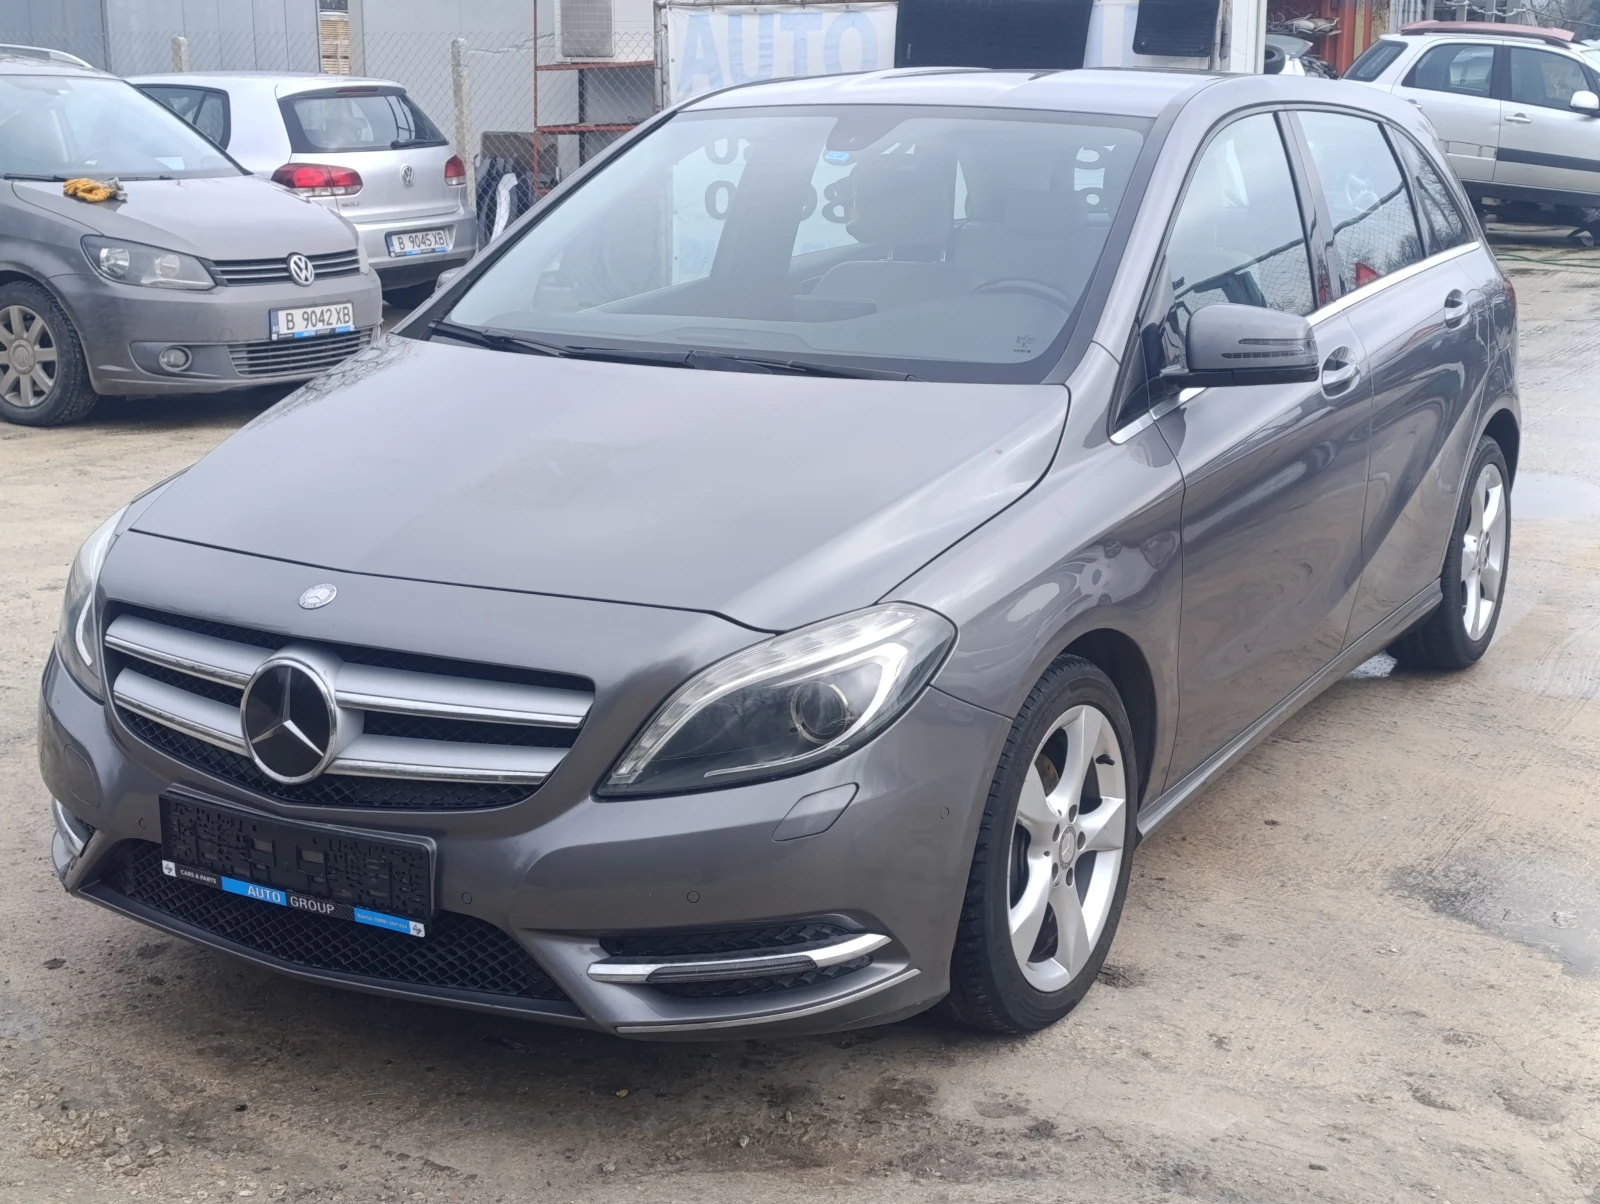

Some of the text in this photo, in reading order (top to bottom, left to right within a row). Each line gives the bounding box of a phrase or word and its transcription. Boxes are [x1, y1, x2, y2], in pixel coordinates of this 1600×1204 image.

[677, 11, 878, 92] AUTO
[397, 232, 445, 251] B 9045 XB
[285, 306, 351, 331] B 9042 XB
[180, 869, 195, 878] CARS
[200, 874, 217, 884] PARTS
[247, 885, 281, 903] AUTO
[289, 895, 335, 914] GROUP
